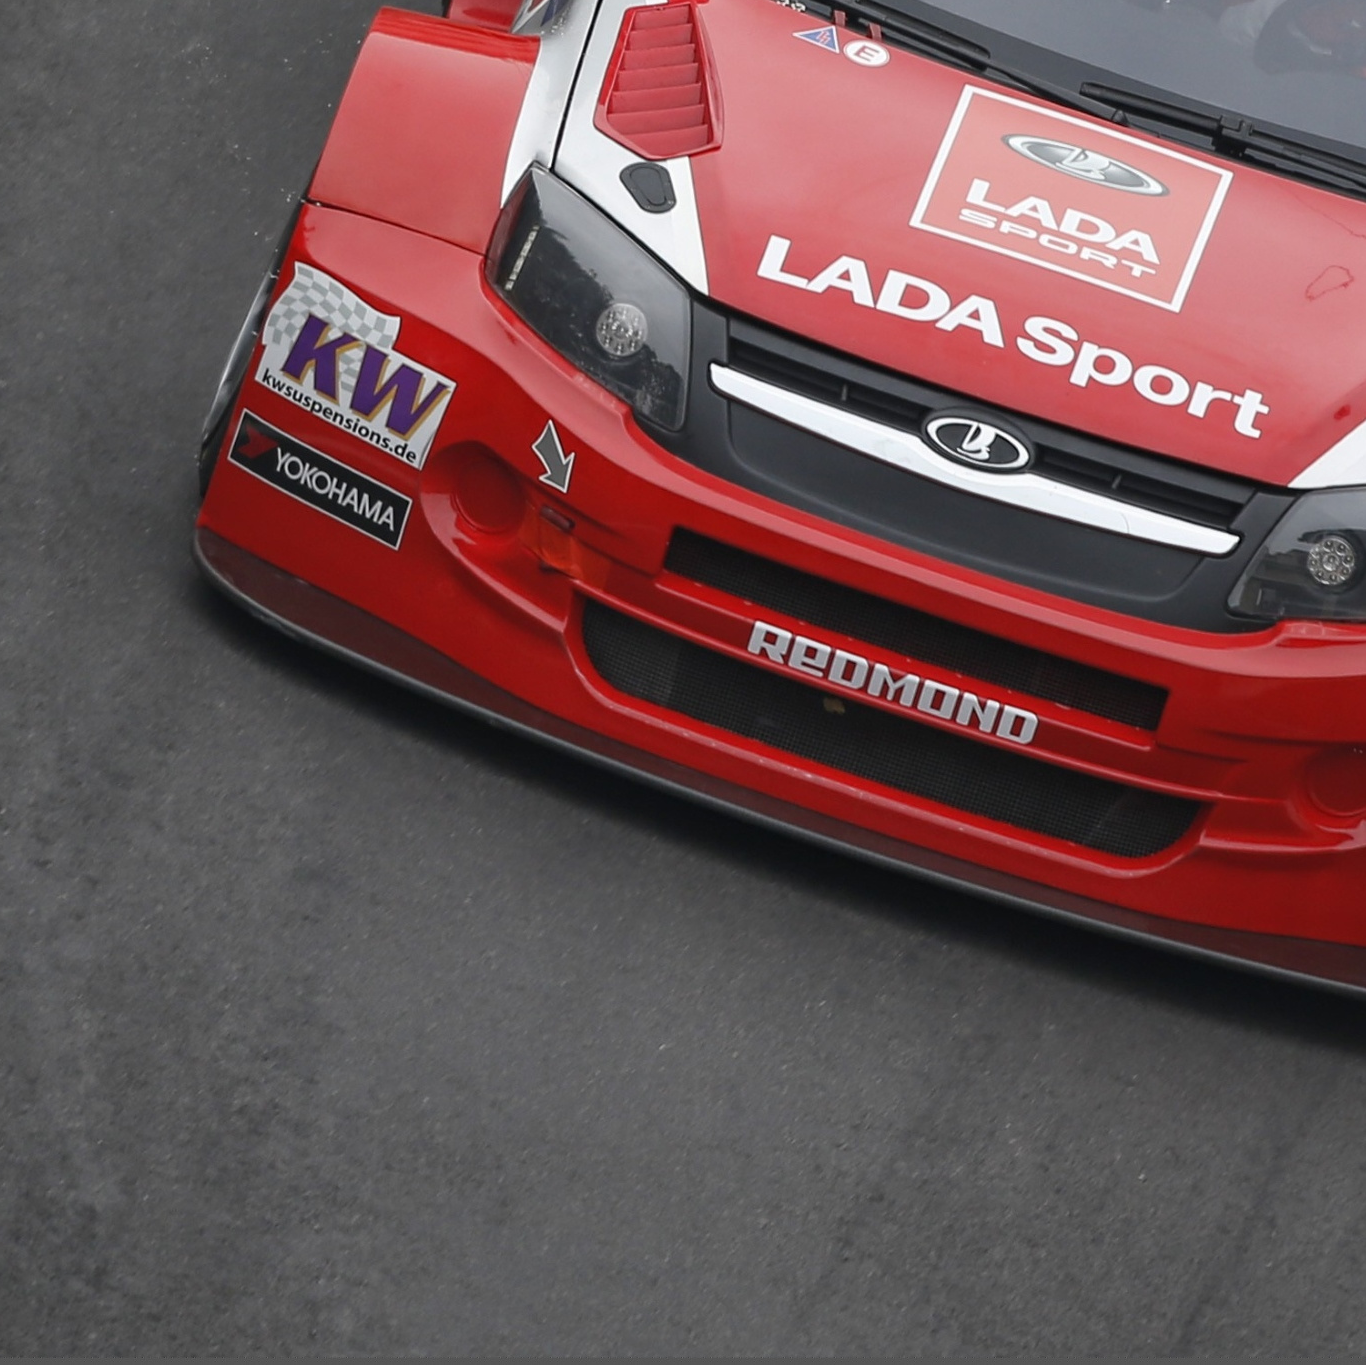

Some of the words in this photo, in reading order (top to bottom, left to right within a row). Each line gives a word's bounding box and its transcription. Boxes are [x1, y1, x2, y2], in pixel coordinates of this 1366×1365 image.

[854, 44, 881, 62] E
[958, 207, 1157, 278] SPORT
[965, 178, 1161, 265] LADA
[281, 313, 452, 441] KW
[756, 234, 1005, 349] LADA
[1016, 315, 1271, 439] Sport
[261, 369, 418, 463] kwsuspensions.de
[275, 447, 396, 532] YOKOHAMA
